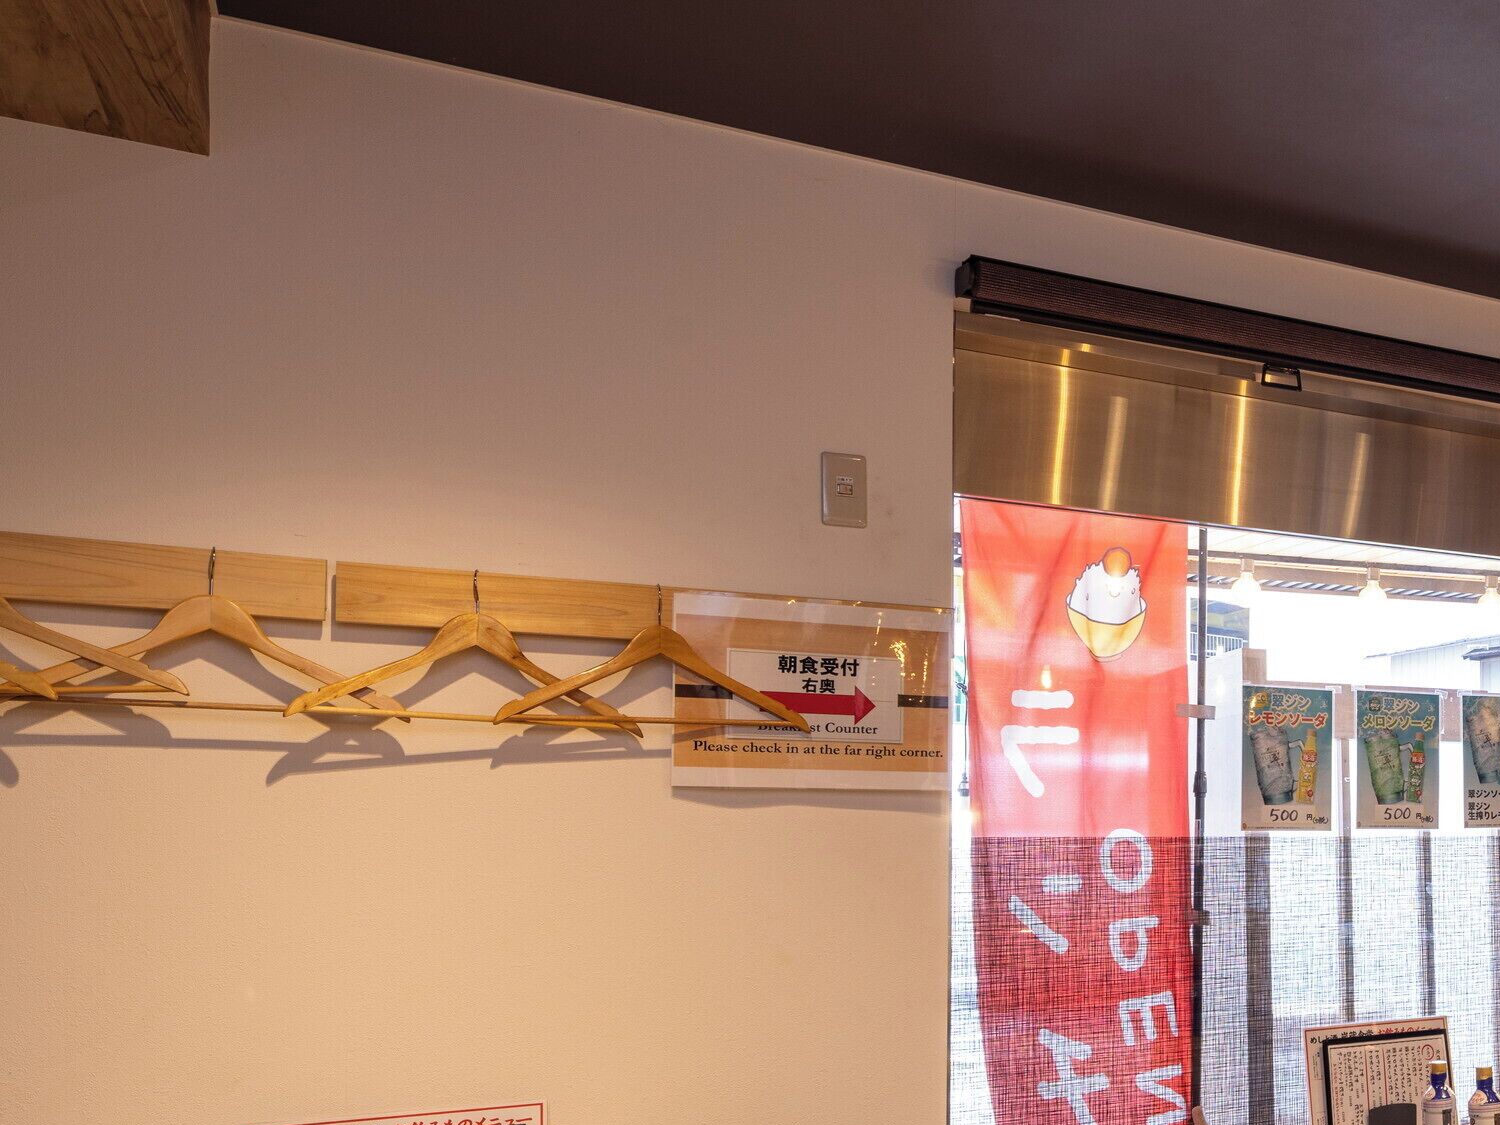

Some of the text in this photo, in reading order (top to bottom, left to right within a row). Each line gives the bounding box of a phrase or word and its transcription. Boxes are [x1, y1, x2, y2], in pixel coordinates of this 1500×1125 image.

[778, 655, 860, 677] 朝食受付
[802, 678, 835, 694] 右奥
[1249, 710, 1328, 728] レモンソーダ
[1362, 714, 1437, 731] メロンソーダ
[825, 722, 877, 735] Counter
[693, 740, 943, 759] Please check in at the far right corner.
[1384, 807, 1411, 820] 500
[1468, 802, 1491, 810] 翠ジン
[1269, 808, 1298, 822] 500
